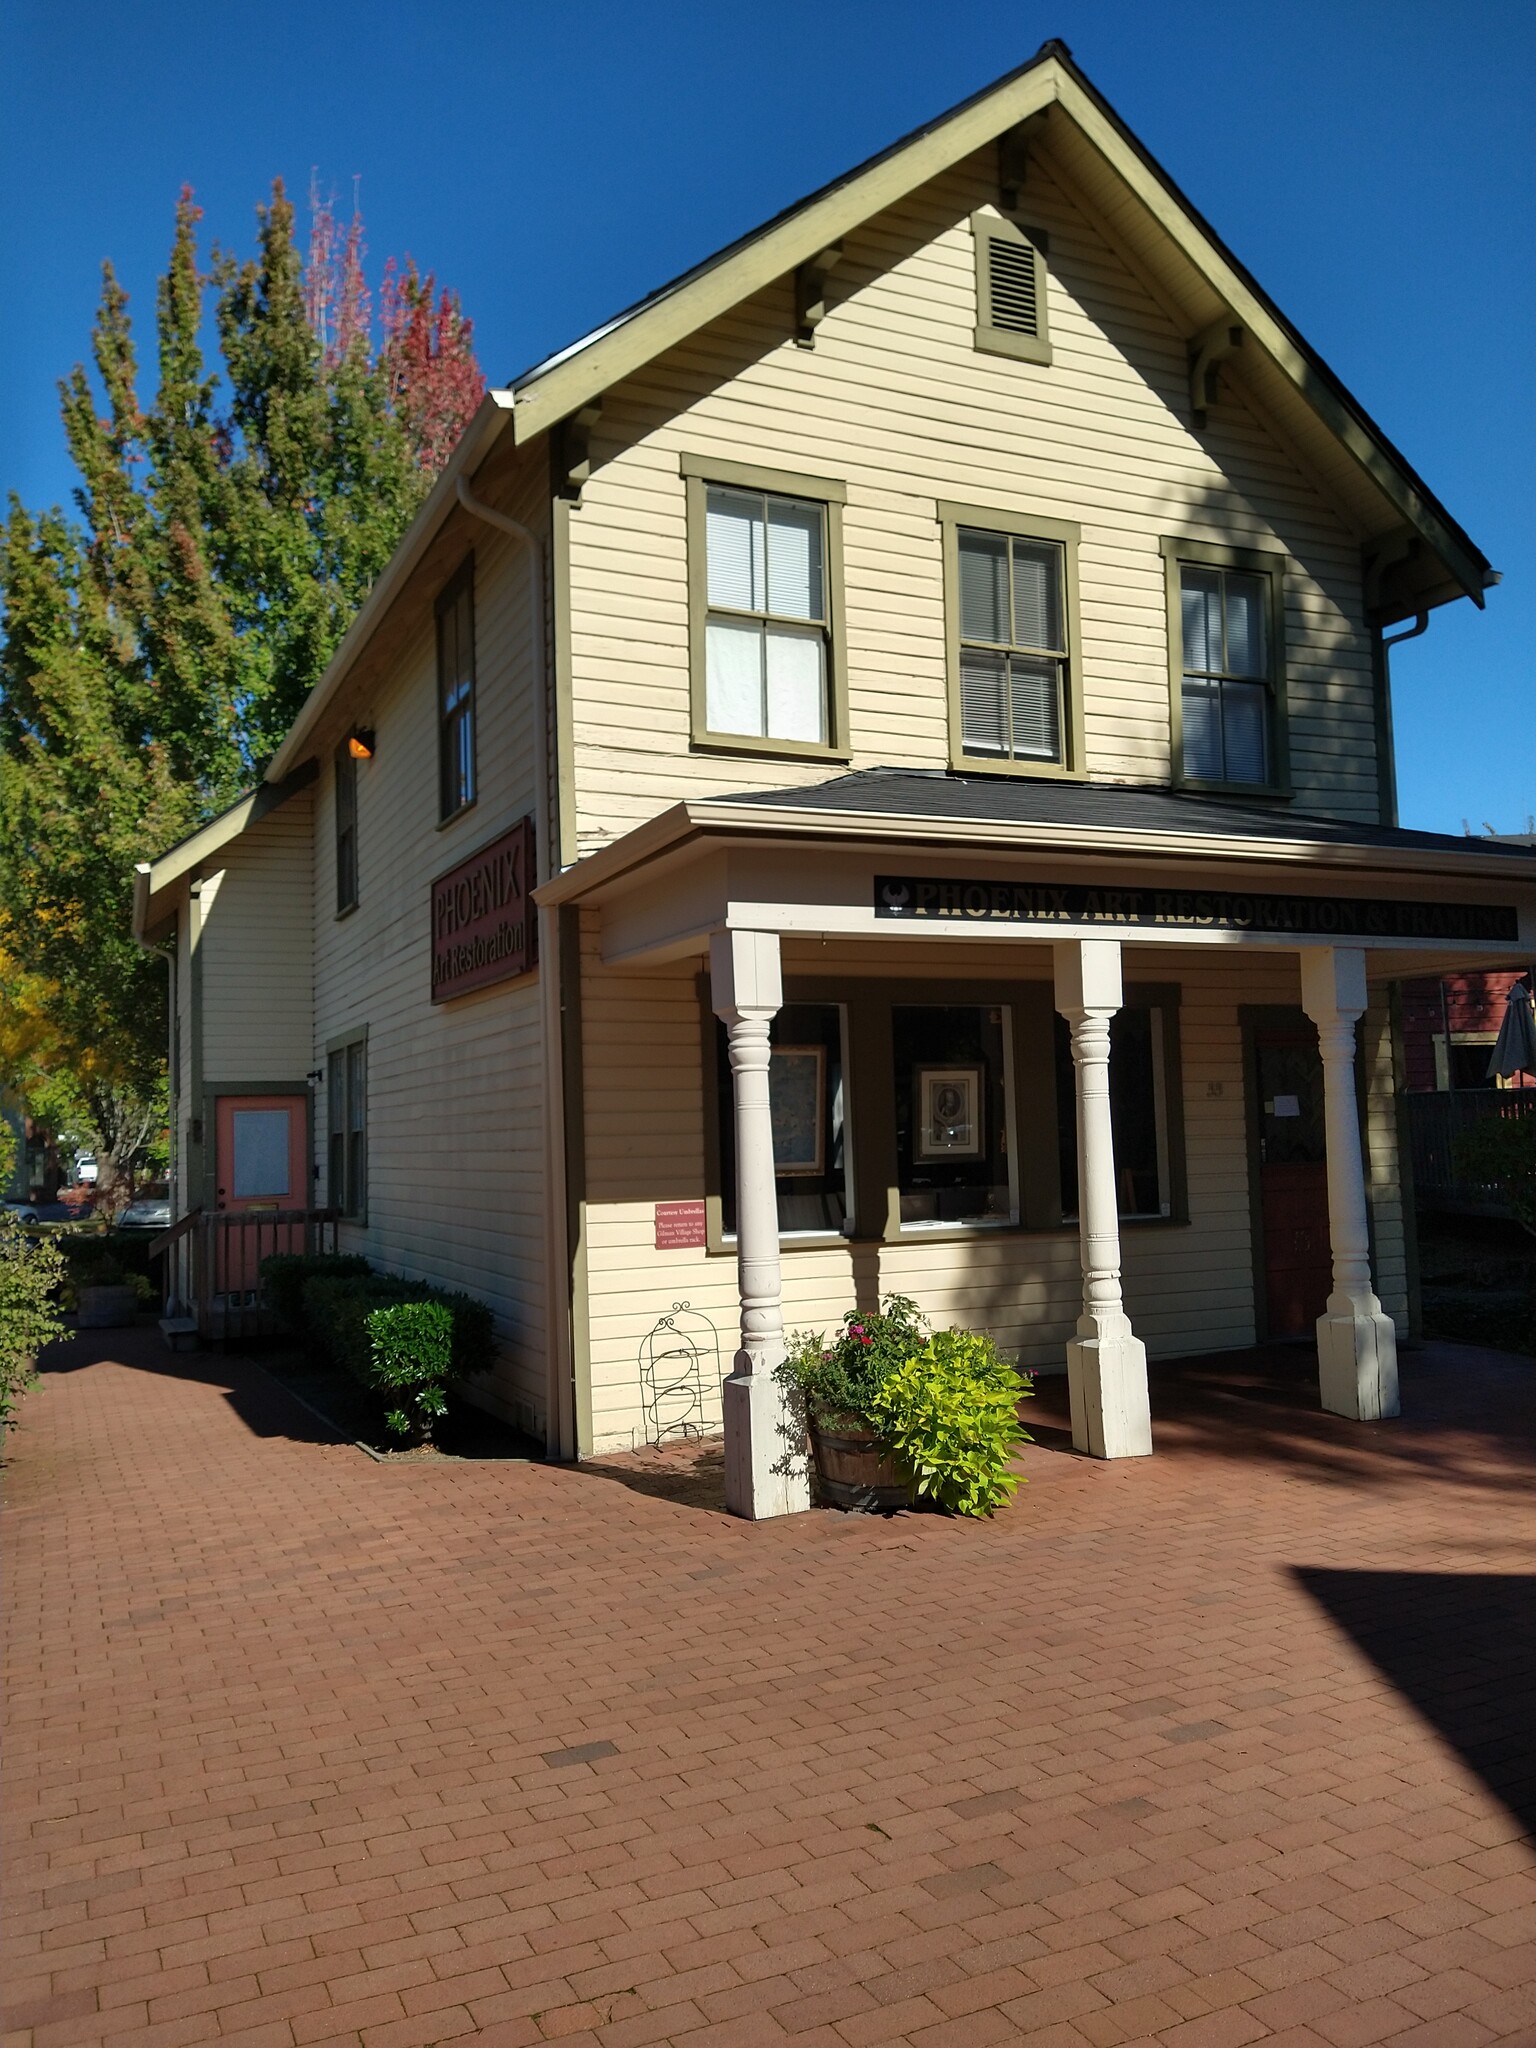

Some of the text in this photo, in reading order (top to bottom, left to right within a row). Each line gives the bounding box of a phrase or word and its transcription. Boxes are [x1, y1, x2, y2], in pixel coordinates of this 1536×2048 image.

[435, 845, 520, 939] PHOENIX
[914, 882, 1514, 936] PHOENIX ART RESTORATION & FRAMING
[432, 921, 524, 986] Art Restoration
[679, 1207, 704, 1215] Umbrellas
